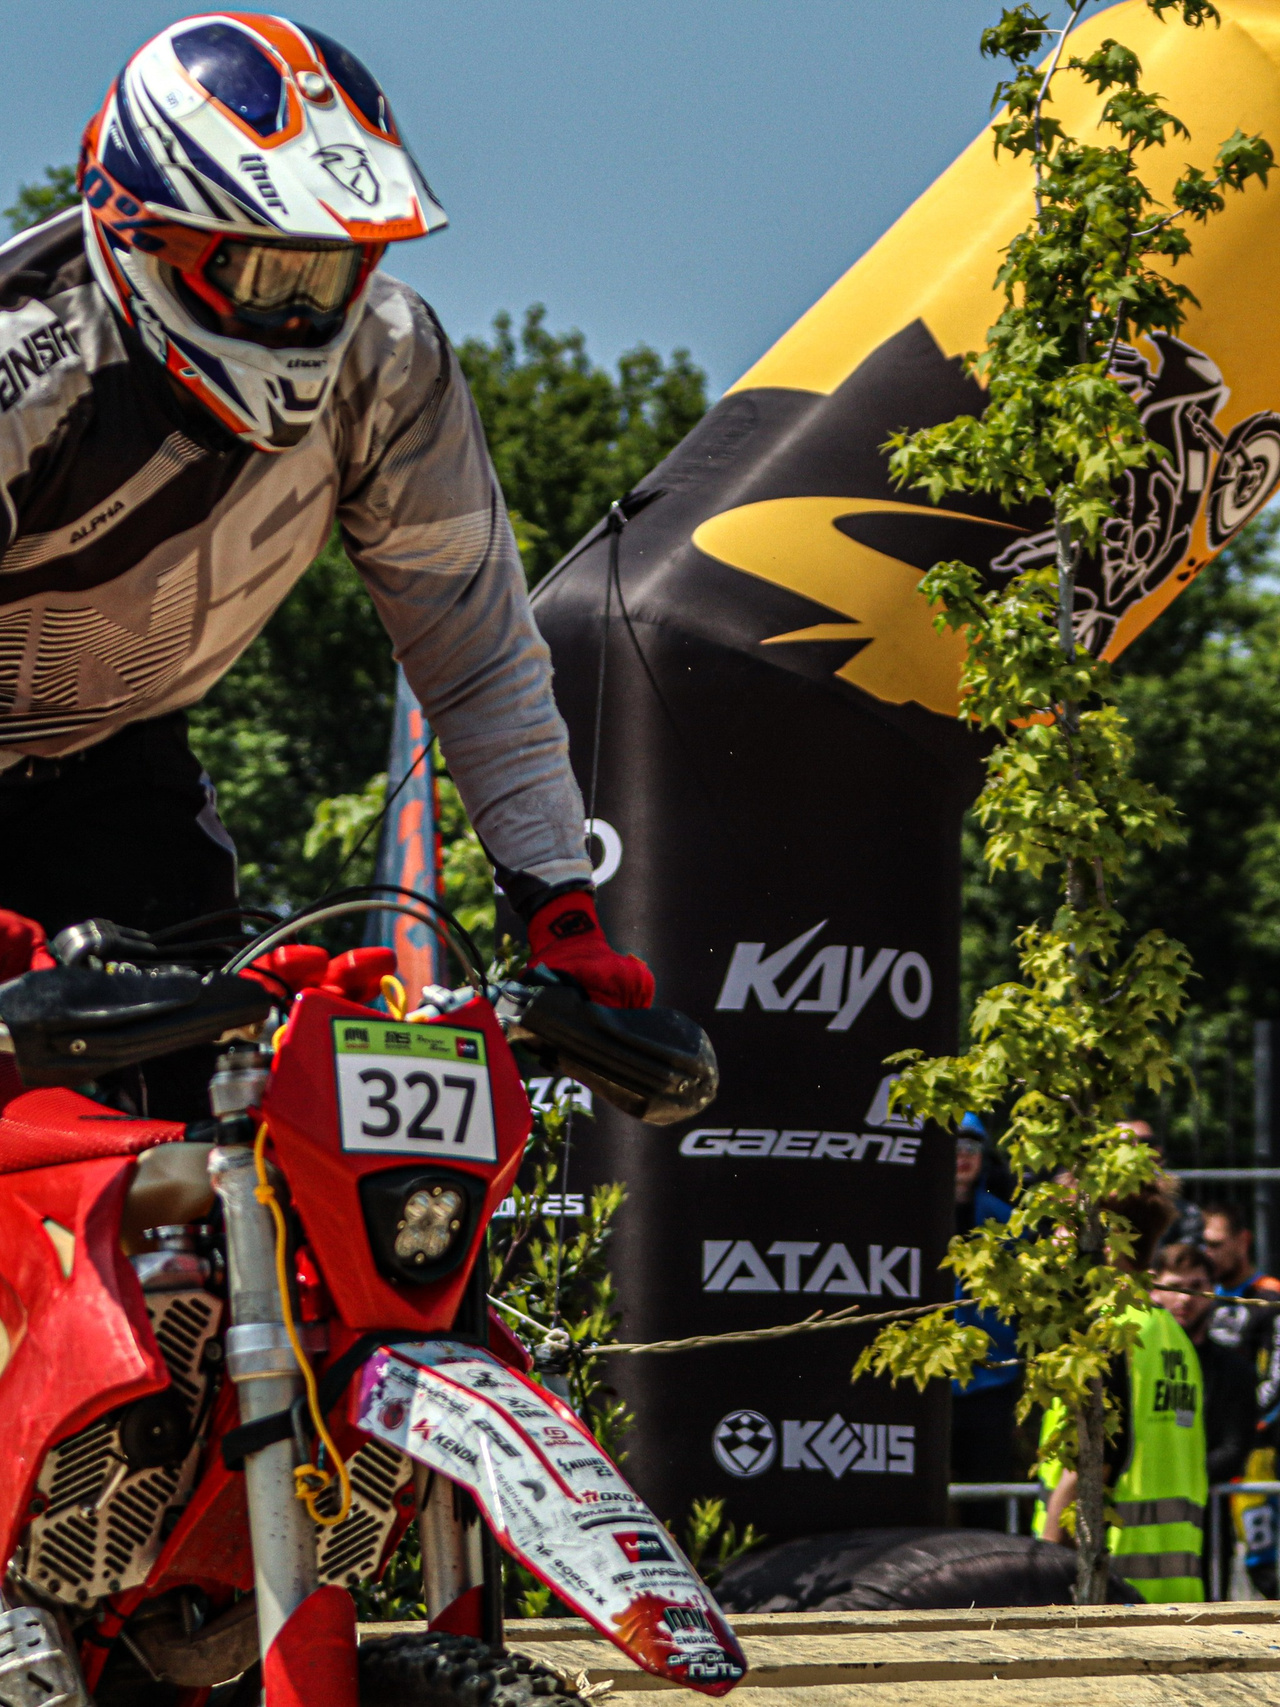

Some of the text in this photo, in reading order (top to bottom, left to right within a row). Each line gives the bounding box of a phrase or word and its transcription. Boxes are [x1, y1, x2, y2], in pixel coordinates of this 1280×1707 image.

[69, 501, 126, 545] ALPHA
[715, 918, 933, 1032] KAYO
[358, 1067, 477, 1144] 327
[431, 1432, 479, 1467] KENDA
[675, 1635, 718, 1646] ENDURO
[688, 1663, 743, 1678] ПУТЬ
